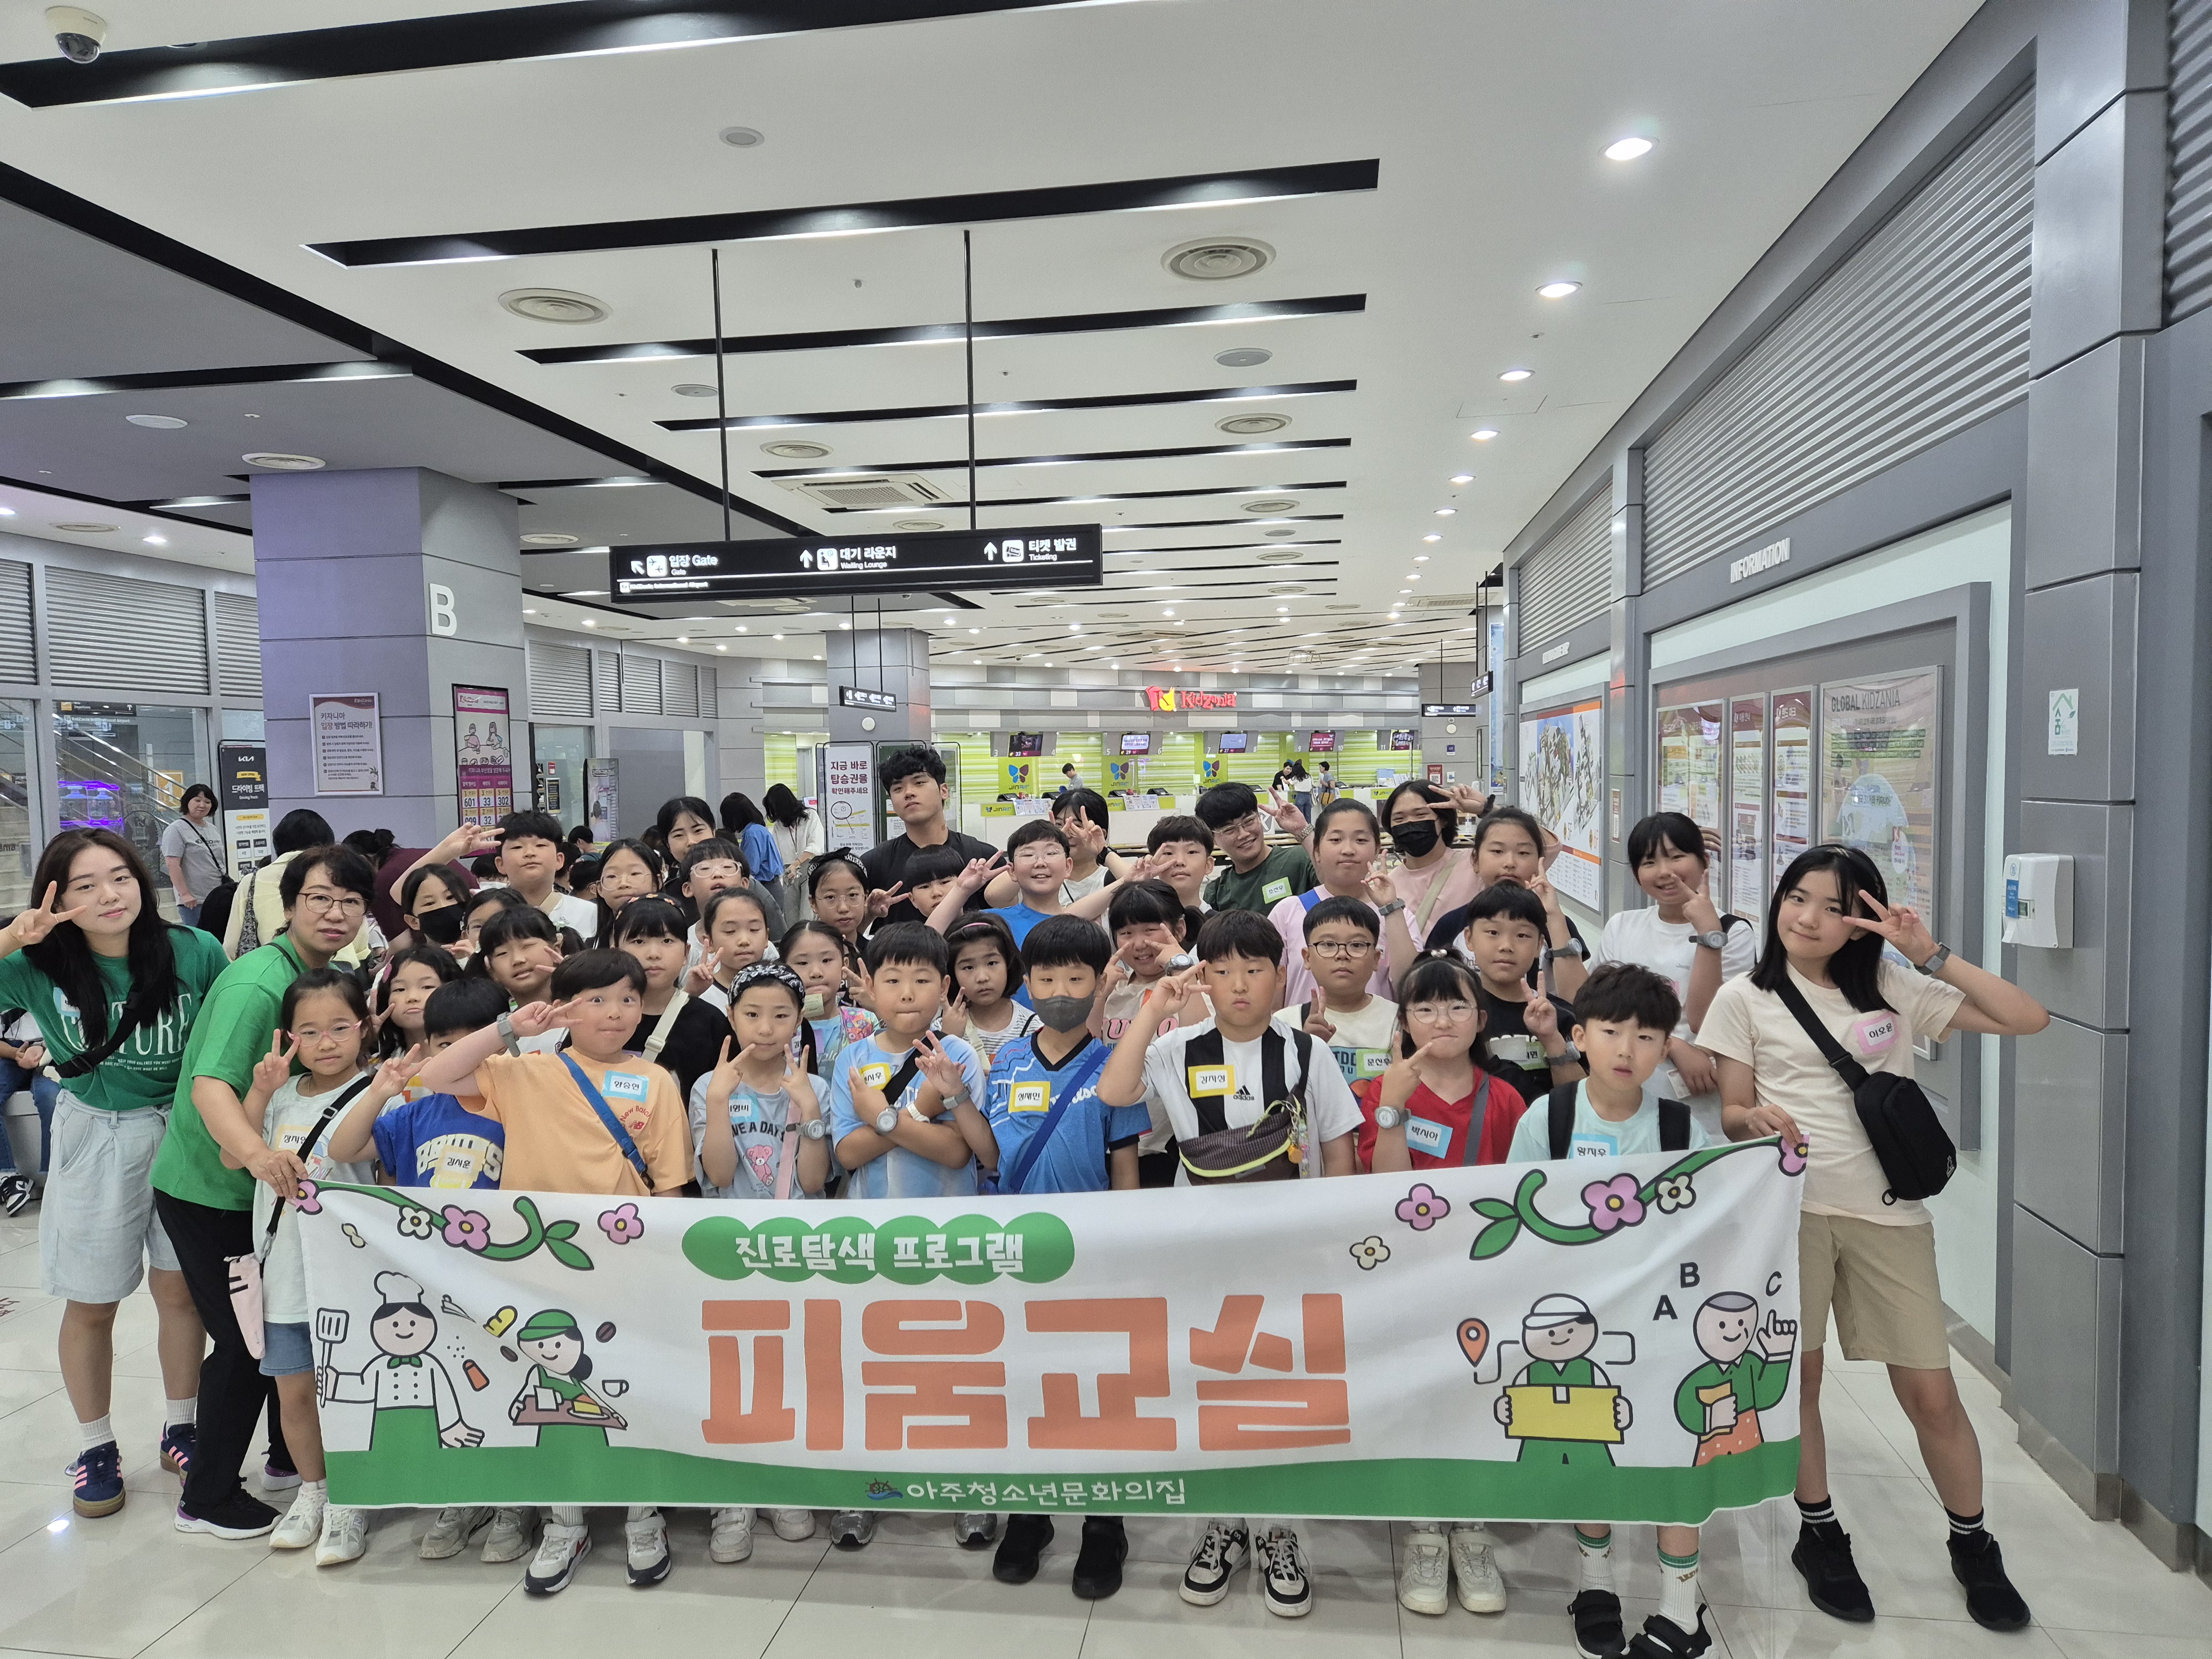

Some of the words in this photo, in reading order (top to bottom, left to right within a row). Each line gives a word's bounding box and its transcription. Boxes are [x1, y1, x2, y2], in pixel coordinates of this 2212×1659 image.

[1029, 539, 1051, 552] 티켓
[1054, 538, 1077, 551] 발권
[840, 547, 861, 560] 대기
[864, 546, 896, 559] 라운지
[669, 555, 690, 567] 입장
[692, 555, 718, 566] Gate
[1730, 538, 1790, 583] INFORMATION
[430, 583, 457, 637] B
[1832, 694, 1860, 712] GLOBAL
[1862, 689, 1900, 709] KIDZANIA
[321, 721, 333, 730] 입장
[334, 721, 346, 729] 방법
[831, 761, 847, 770] 지금
[851, 761, 868, 770] 바로
[831, 774, 868, 784] 탑승권을
[232, 784, 253, 793] 드라이빙
[254, 784, 264, 792] 트랙
[465, 798, 475, 807] 601
[483, 797, 491, 806] 33
[498, 796, 509, 805] 302
[484, 816, 492, 825] 32
[865, 1072, 881, 1084] 시우
[620, 1107, 634, 1121] New
[749, 1121, 757, 1133] A
[736, 1233, 875, 1271] 진로탐색
[894, 1232, 1023, 1272] 프로그램
[1680, 1262, 1700, 1288] B
[1766, 1271, 1782, 1296] C
[1652, 1295, 1678, 1321] A
[702, 1293, 1351, 1451] 피움교실
[907, 1479, 1186, 1505] 아주청소년문화의집
